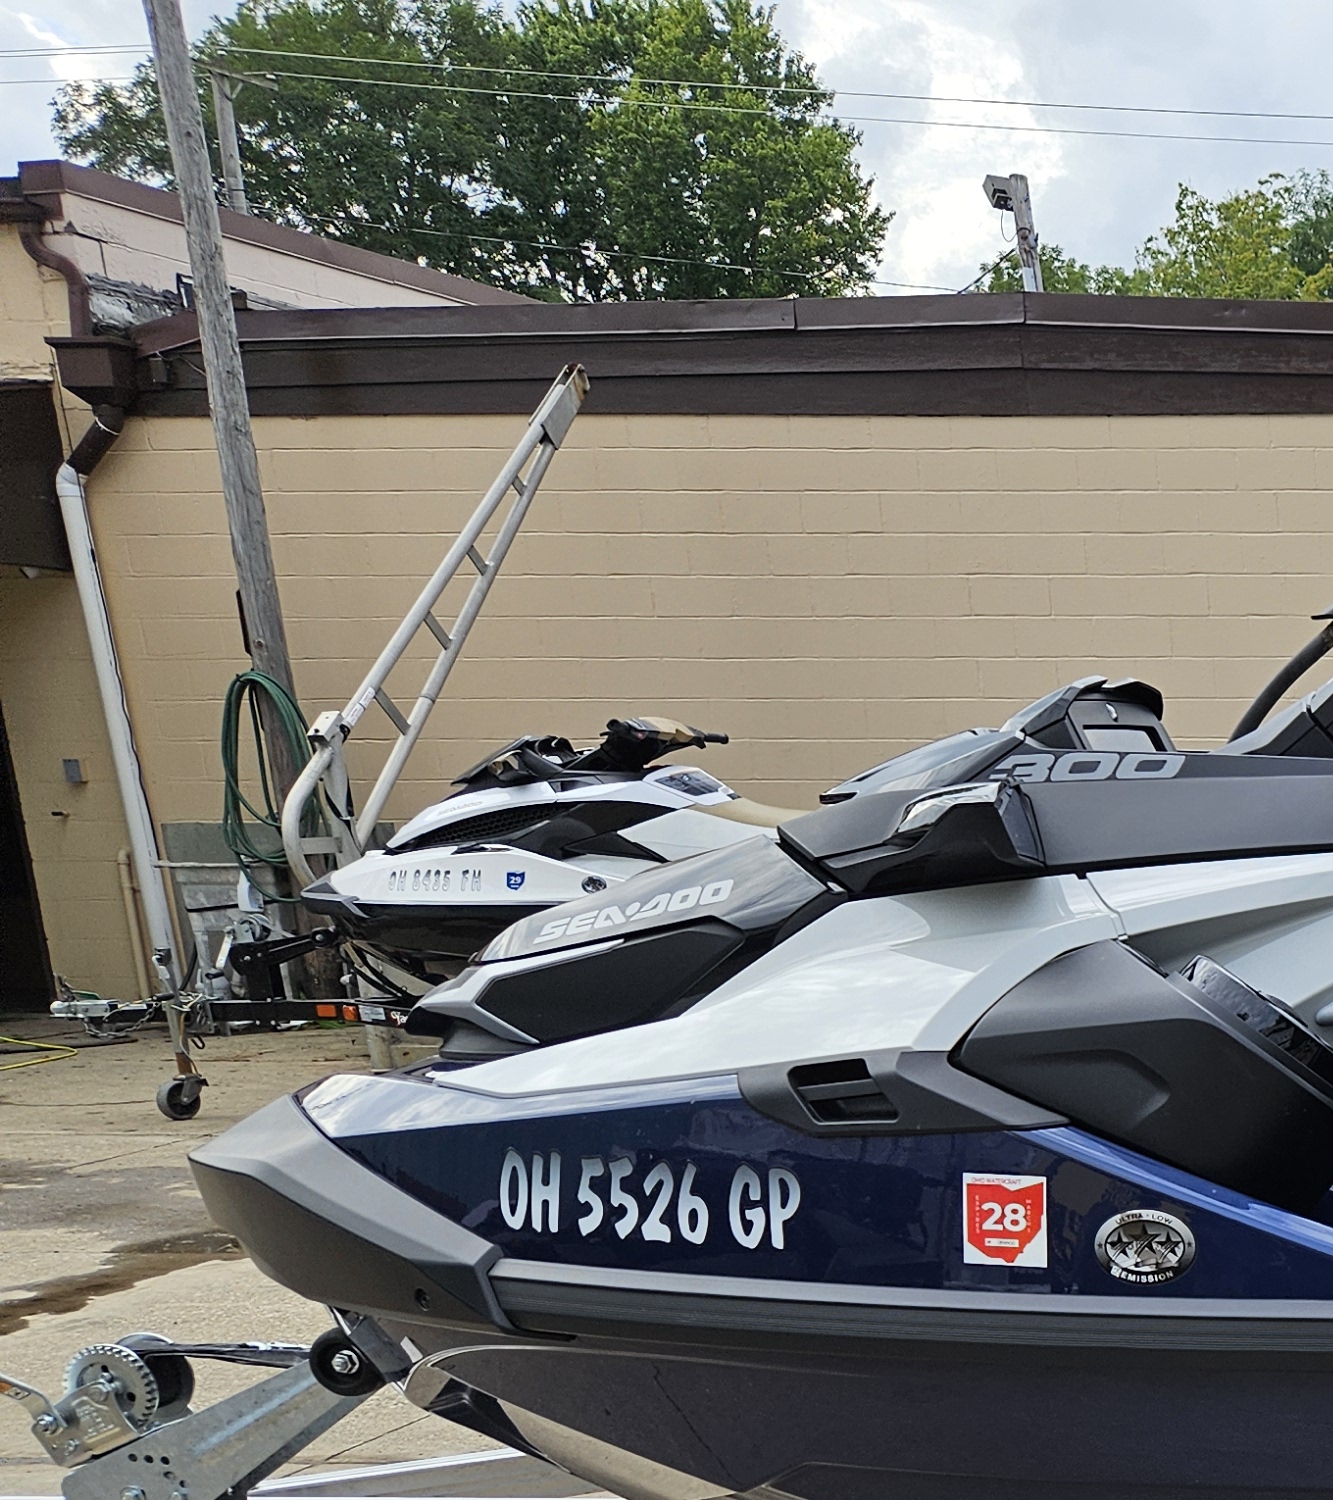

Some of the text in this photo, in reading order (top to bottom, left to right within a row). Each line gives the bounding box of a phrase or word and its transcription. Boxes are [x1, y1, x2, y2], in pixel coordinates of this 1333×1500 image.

[988, 752, 1187, 783] 300
[388, 869, 482, 892] OH 8435 FH
[509, 875, 522, 885] 29
[499, 1147, 801, 1250] OH 5526 GP
[981, 1201, 1027, 1232] 28
[1115, 1212, 1173, 1225] ULTRA LOW
